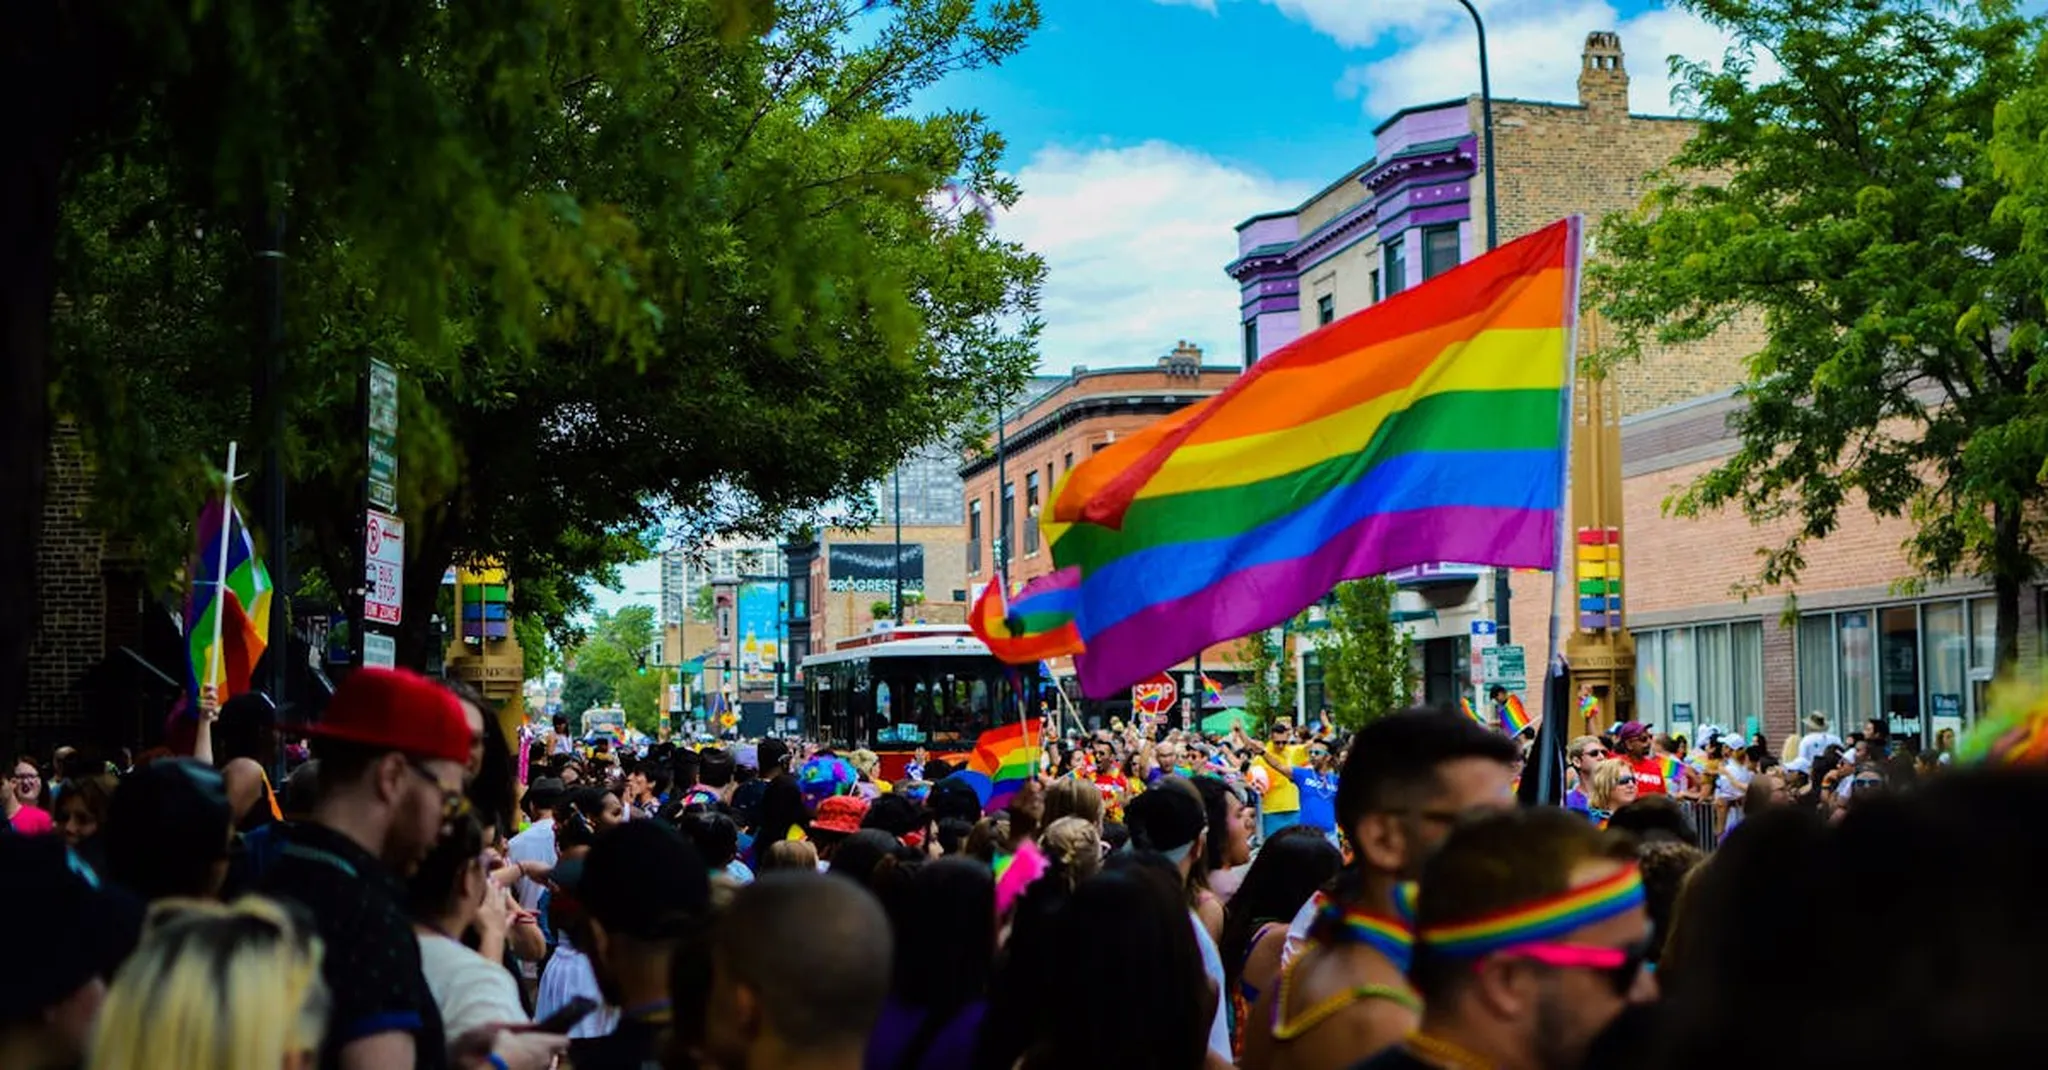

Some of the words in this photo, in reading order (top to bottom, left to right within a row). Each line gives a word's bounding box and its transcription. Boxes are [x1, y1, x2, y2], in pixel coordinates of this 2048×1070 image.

[379, 565, 393, 583] BUS
[378, 583, 396, 602] STOP
[828, 579, 899, 592] PROGRES
